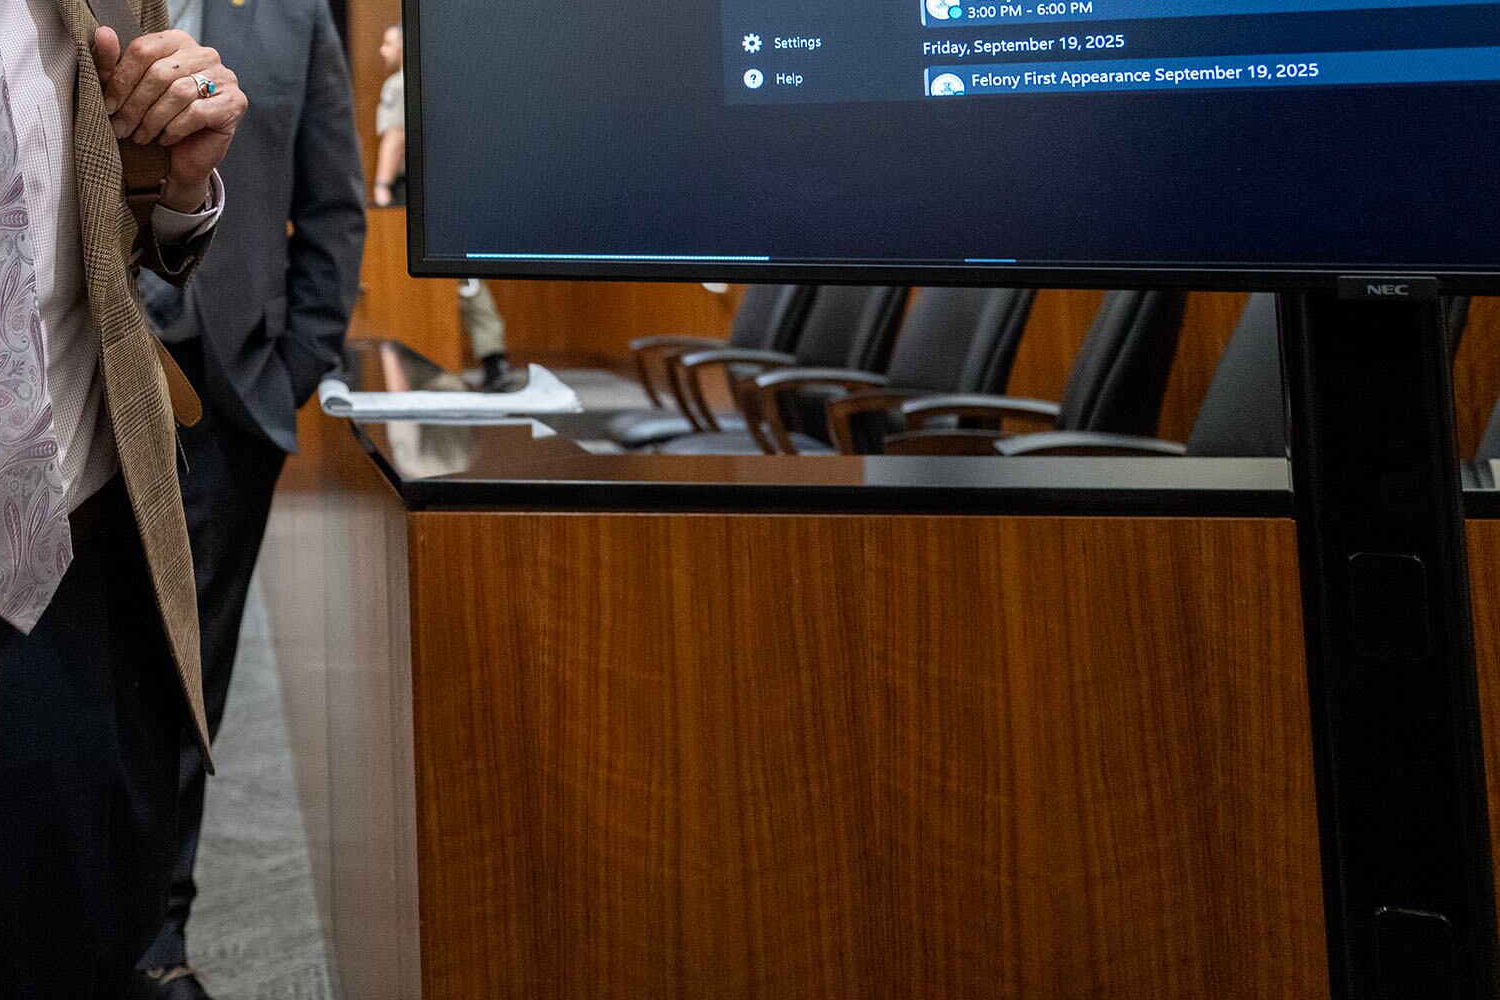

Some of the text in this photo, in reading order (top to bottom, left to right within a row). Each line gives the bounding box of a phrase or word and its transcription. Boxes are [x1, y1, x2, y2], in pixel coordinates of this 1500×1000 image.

[968, 5, 996, 18] 3:00
[1000, 5, 1022, 17] PM
[1037, 3, 1066, 16] 6:00
[1070, 1, 1092, 14] PM
[775, 37, 821, 50] Settings
[923, 35, 1124, 57] Friday, September 19, 2025
[777, 73, 803, 86] Help
[972, 63, 1318, 89] Felony First Appearance September 19, 2025
[1366, 285, 1409, 295] NEC
